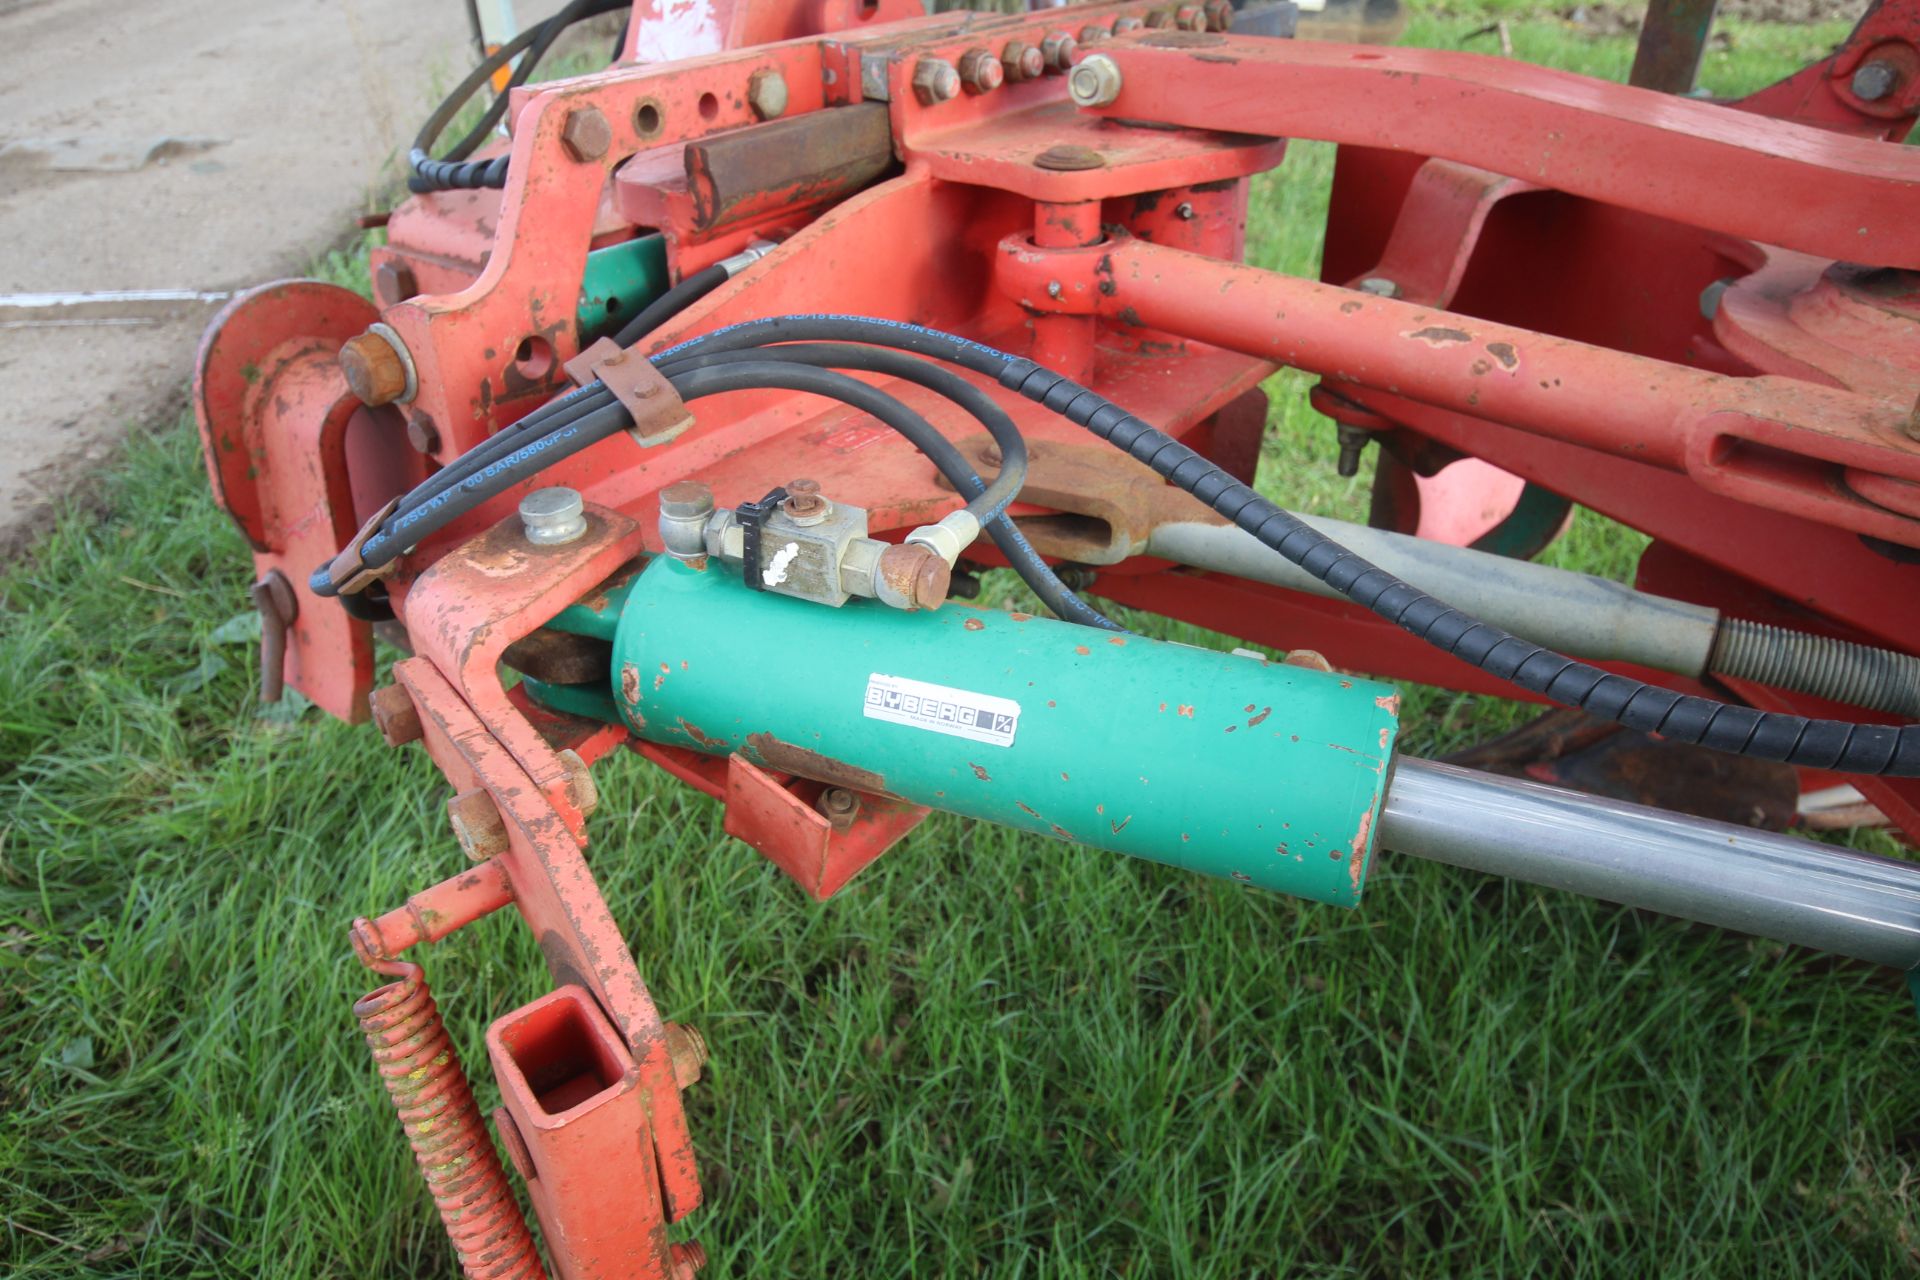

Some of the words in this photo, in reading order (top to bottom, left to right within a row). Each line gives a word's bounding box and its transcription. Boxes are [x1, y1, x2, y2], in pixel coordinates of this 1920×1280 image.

[828, 313, 898, 327] EXCEEDS
[899, 321, 924, 334] DIN
[926, 328, 947, 339] EN
[866, 687, 976, 726] BYBERG
